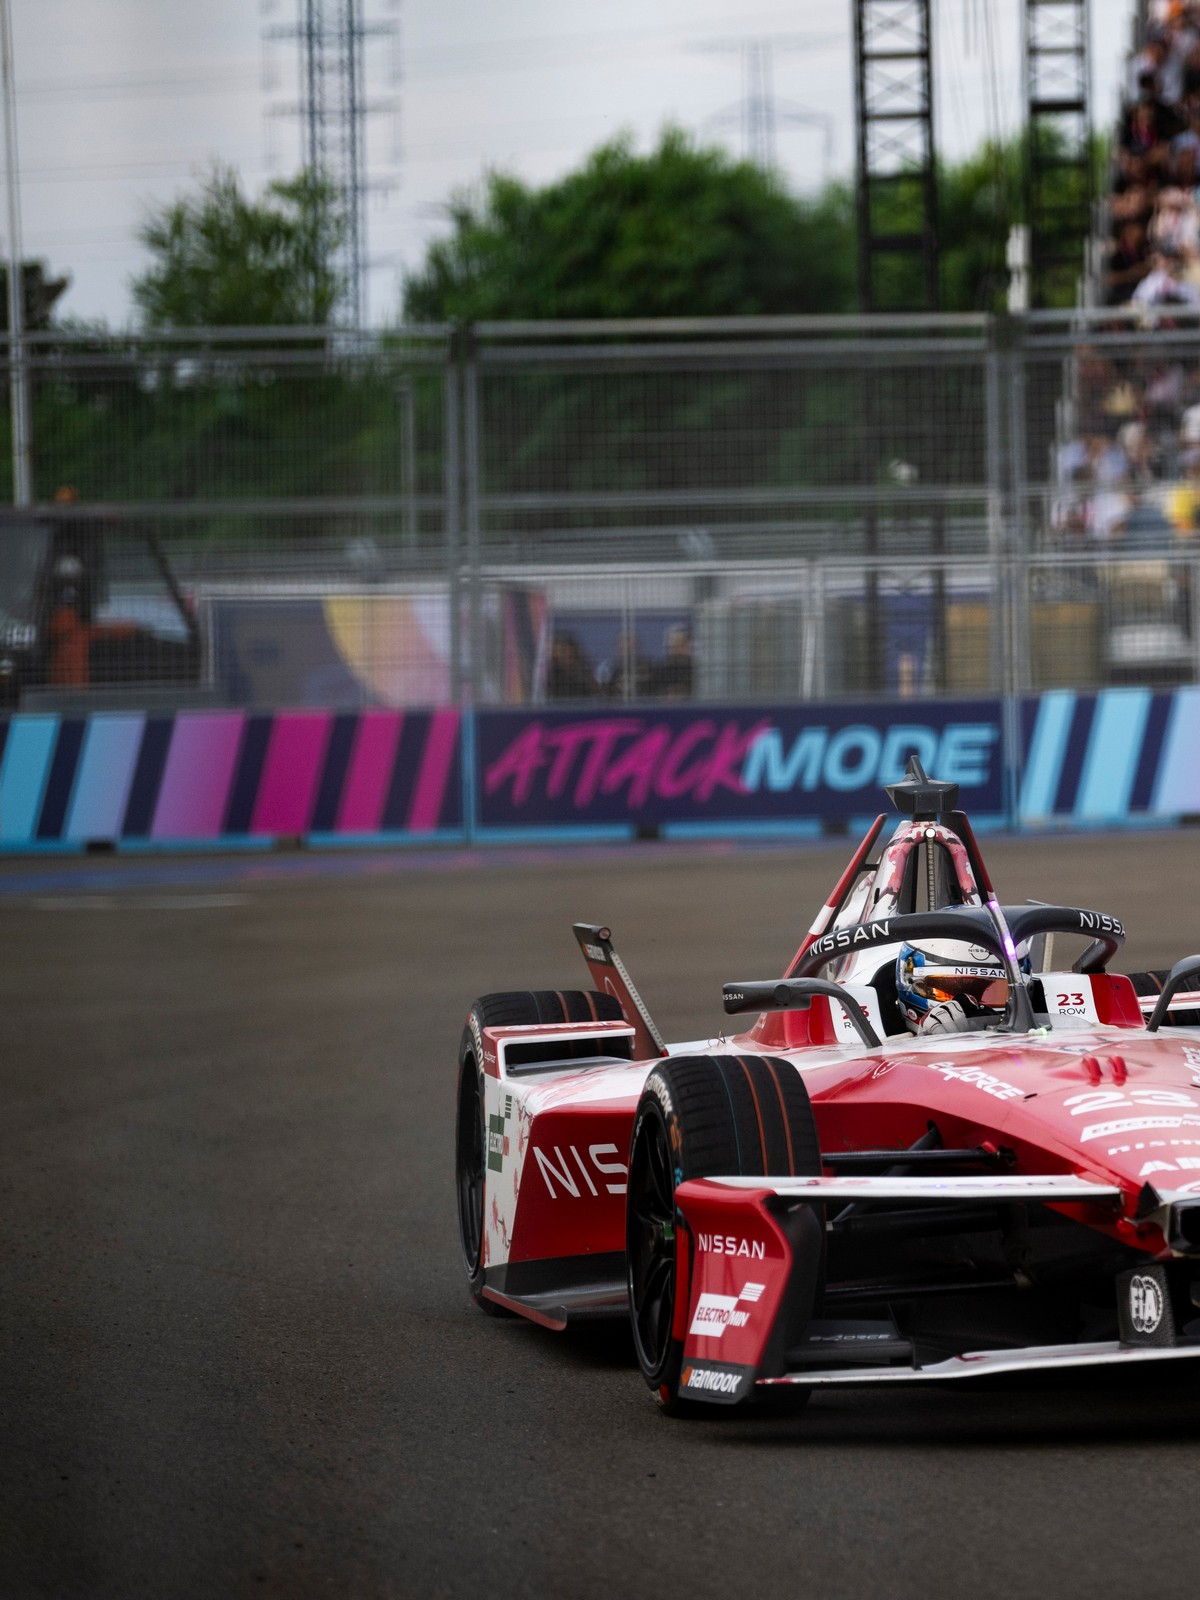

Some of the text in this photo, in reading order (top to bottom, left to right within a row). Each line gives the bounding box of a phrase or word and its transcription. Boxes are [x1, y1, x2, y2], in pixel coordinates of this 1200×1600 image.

[485, 716, 998, 808] ATTACK MODE
[1079, 911, 1126, 937] NISSA
[809, 920, 890, 957] NISSAN
[954, 967, 1006, 978] NISSAN
[722, 993, 744, 1001] ISSAN
[1056, 993, 1085, 1007] 23
[1059, 1007, 1086, 1016] ROW
[1063, 1089, 1199, 1117] 23
[532, 1143, 629, 1199] NIS
[698, 1233, 766, 1260] NISSAN
